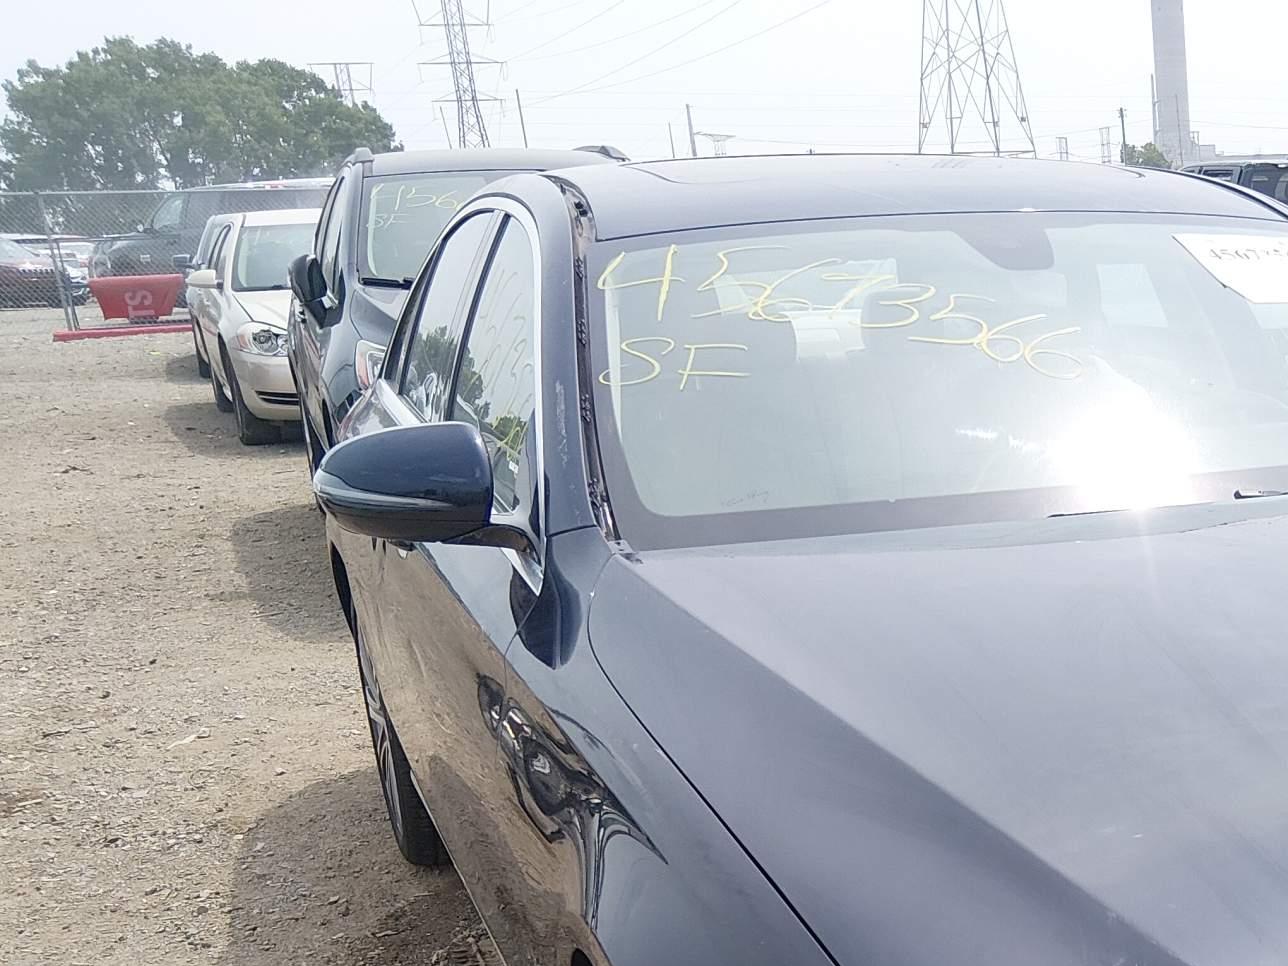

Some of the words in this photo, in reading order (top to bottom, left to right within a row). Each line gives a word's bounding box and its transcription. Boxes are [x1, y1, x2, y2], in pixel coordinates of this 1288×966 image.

[370, 183, 464, 211] 456
[597, 245, 1084, 381] 45673566
[598, 337, 751, 391] SF
